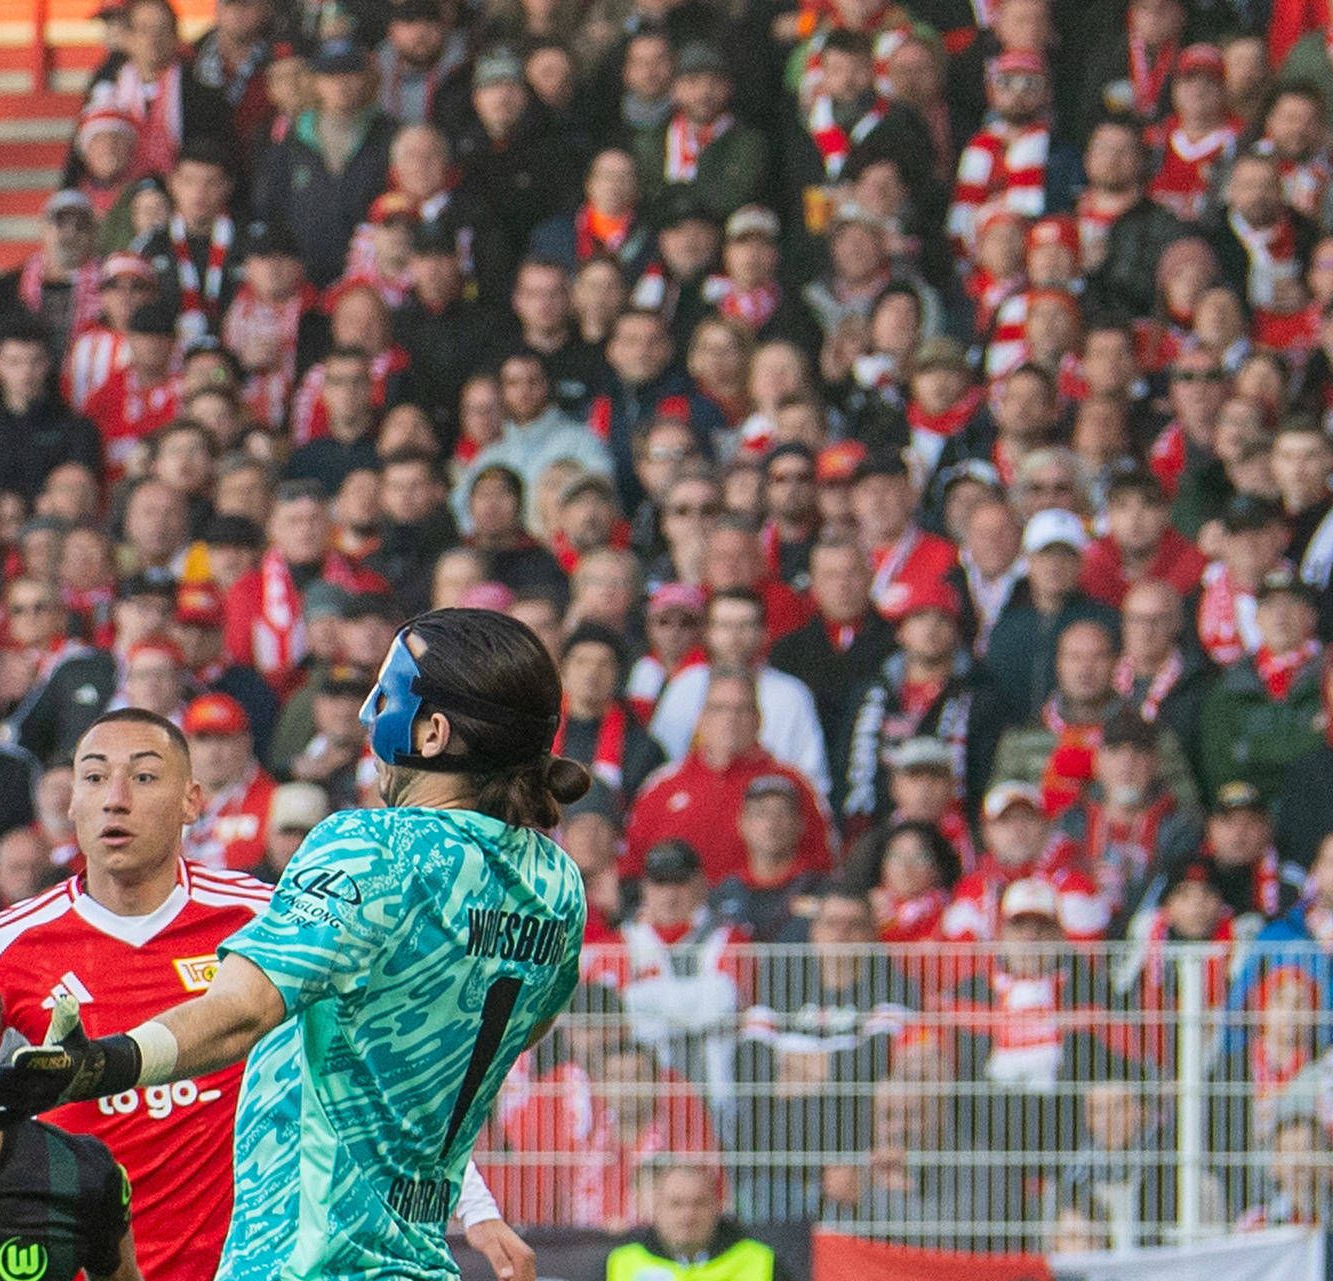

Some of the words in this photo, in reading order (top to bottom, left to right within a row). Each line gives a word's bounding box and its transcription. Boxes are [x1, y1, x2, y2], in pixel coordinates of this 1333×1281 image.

[280, 909, 316, 930] TIRE
[440, 976, 523, 1160] 1
[98, 1088, 139, 1116] to
